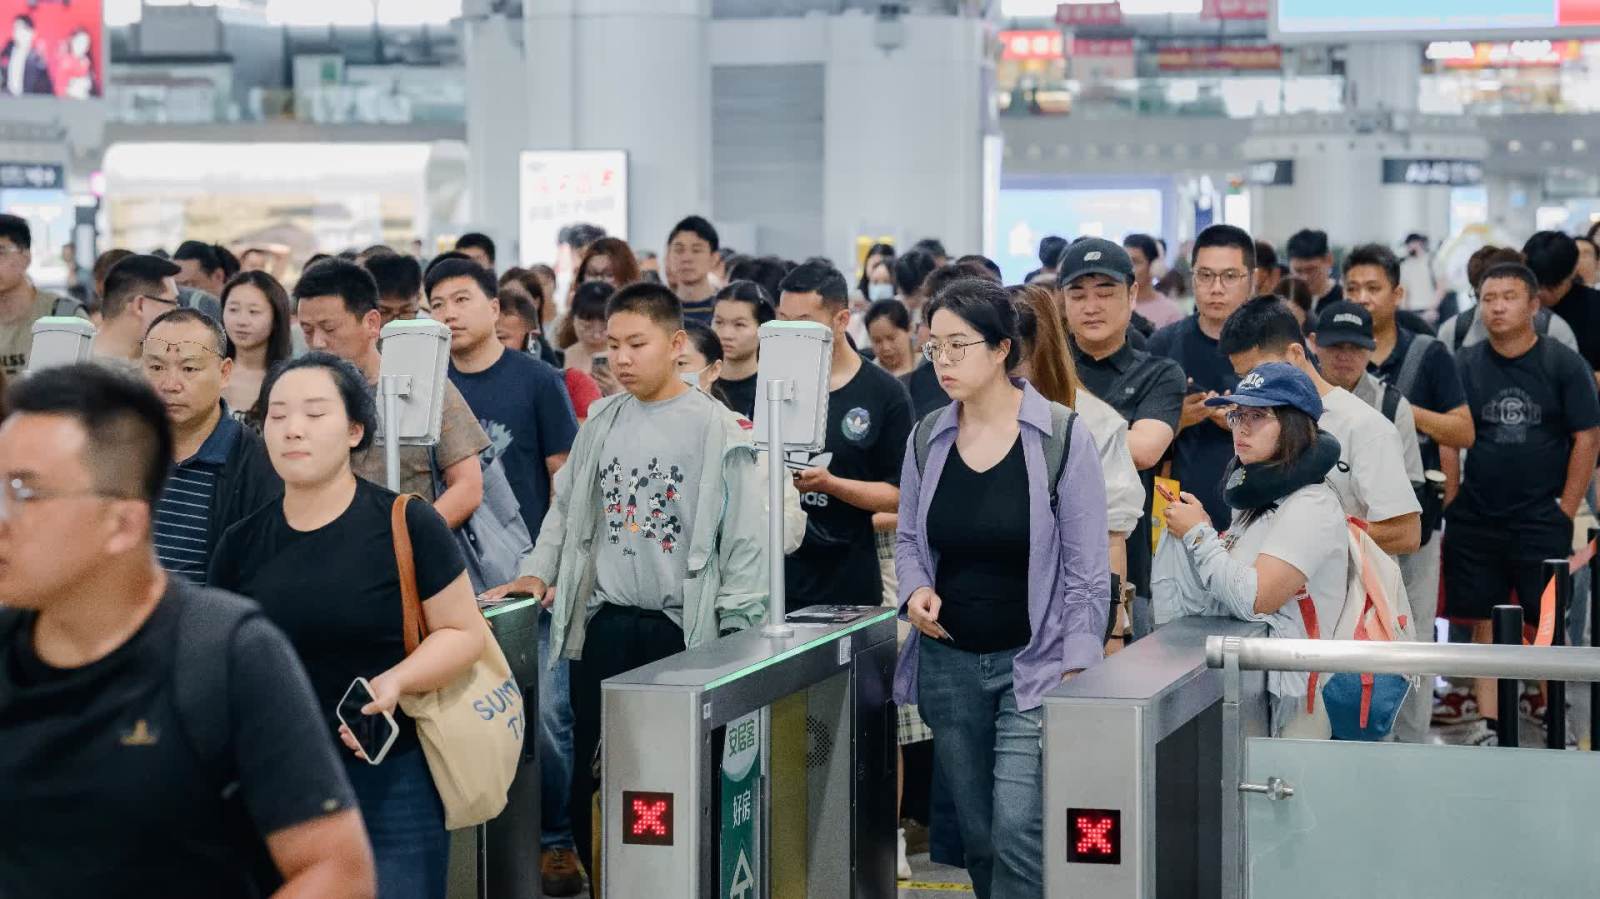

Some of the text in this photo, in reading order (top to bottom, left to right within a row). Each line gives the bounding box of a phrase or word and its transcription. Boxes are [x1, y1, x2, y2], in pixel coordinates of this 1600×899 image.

[800, 491, 829, 507] as
[728, 719, 755, 757] 安居客
[732, 789, 751, 828] 好房
